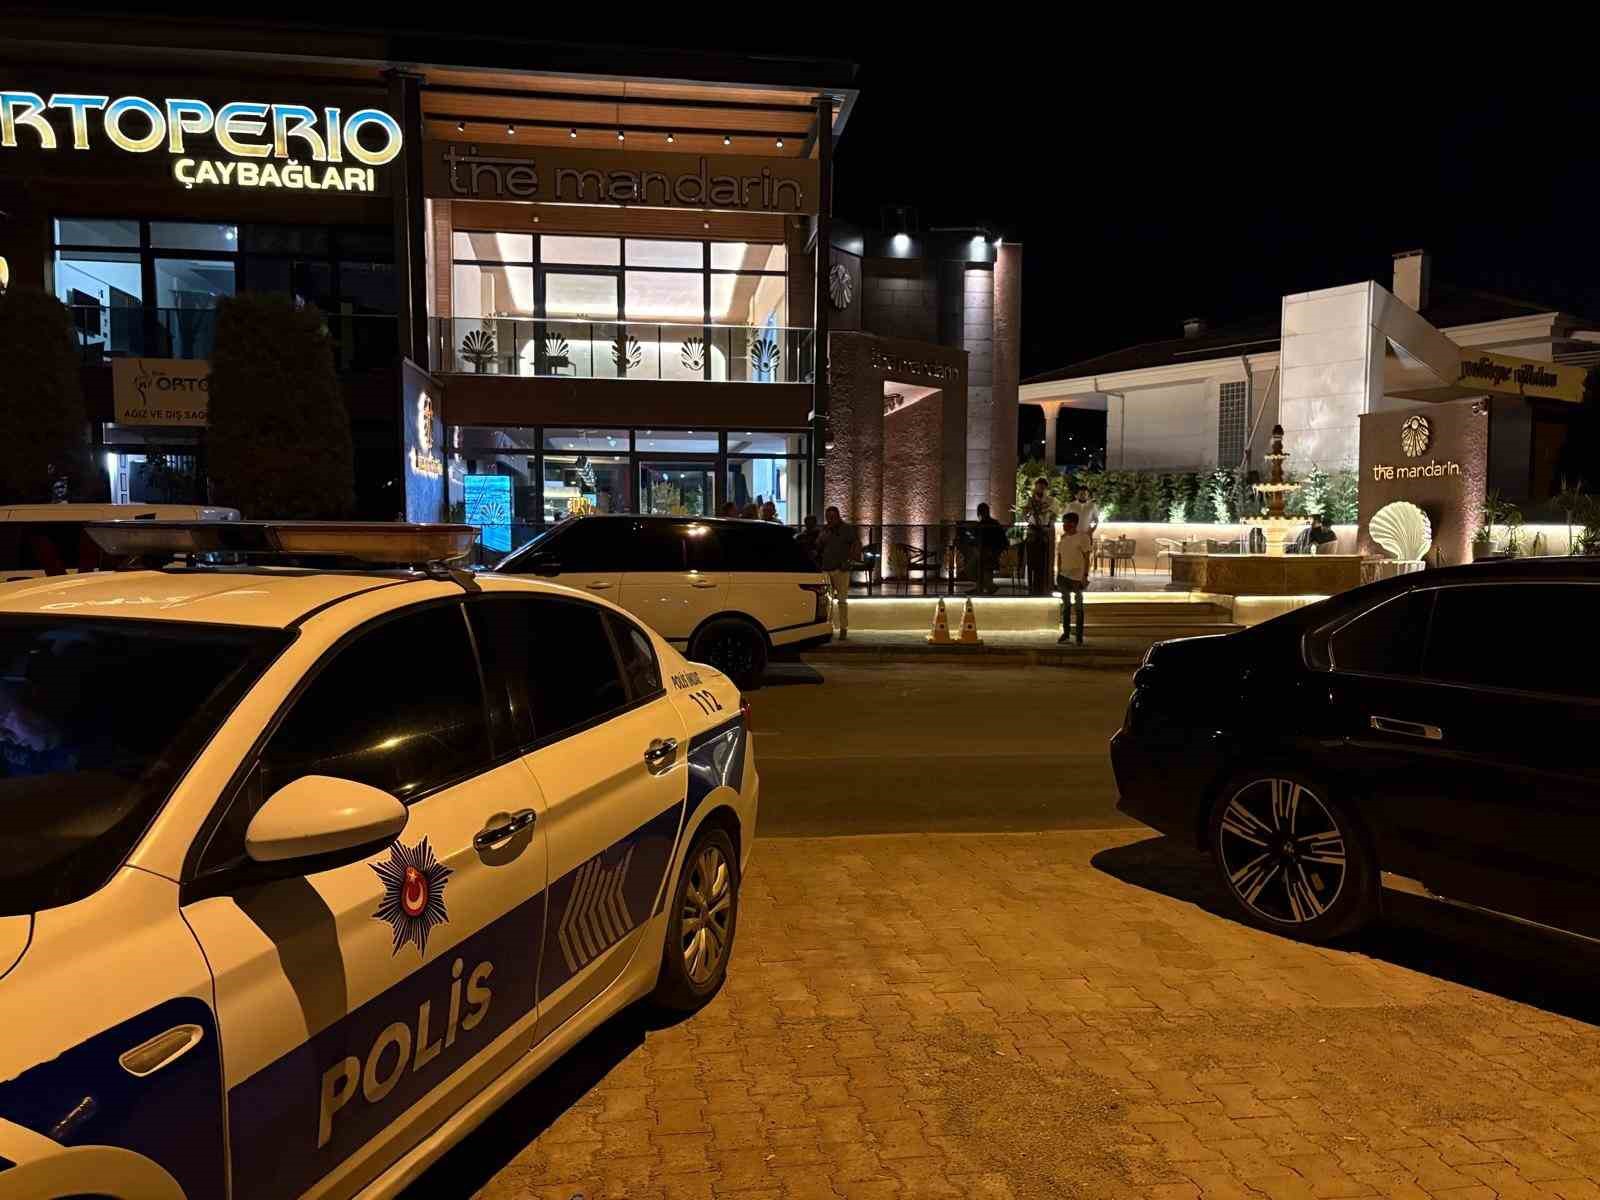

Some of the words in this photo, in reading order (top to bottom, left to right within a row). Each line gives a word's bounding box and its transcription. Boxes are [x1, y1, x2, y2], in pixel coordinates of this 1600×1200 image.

[174, 158, 375, 191] ÇAYBAĞLARI
[443, 144, 539, 195] the
[554, 157, 801, 209] mandarin
[1373, 464, 1395, 480] the
[689, 689, 723, 716] 112
